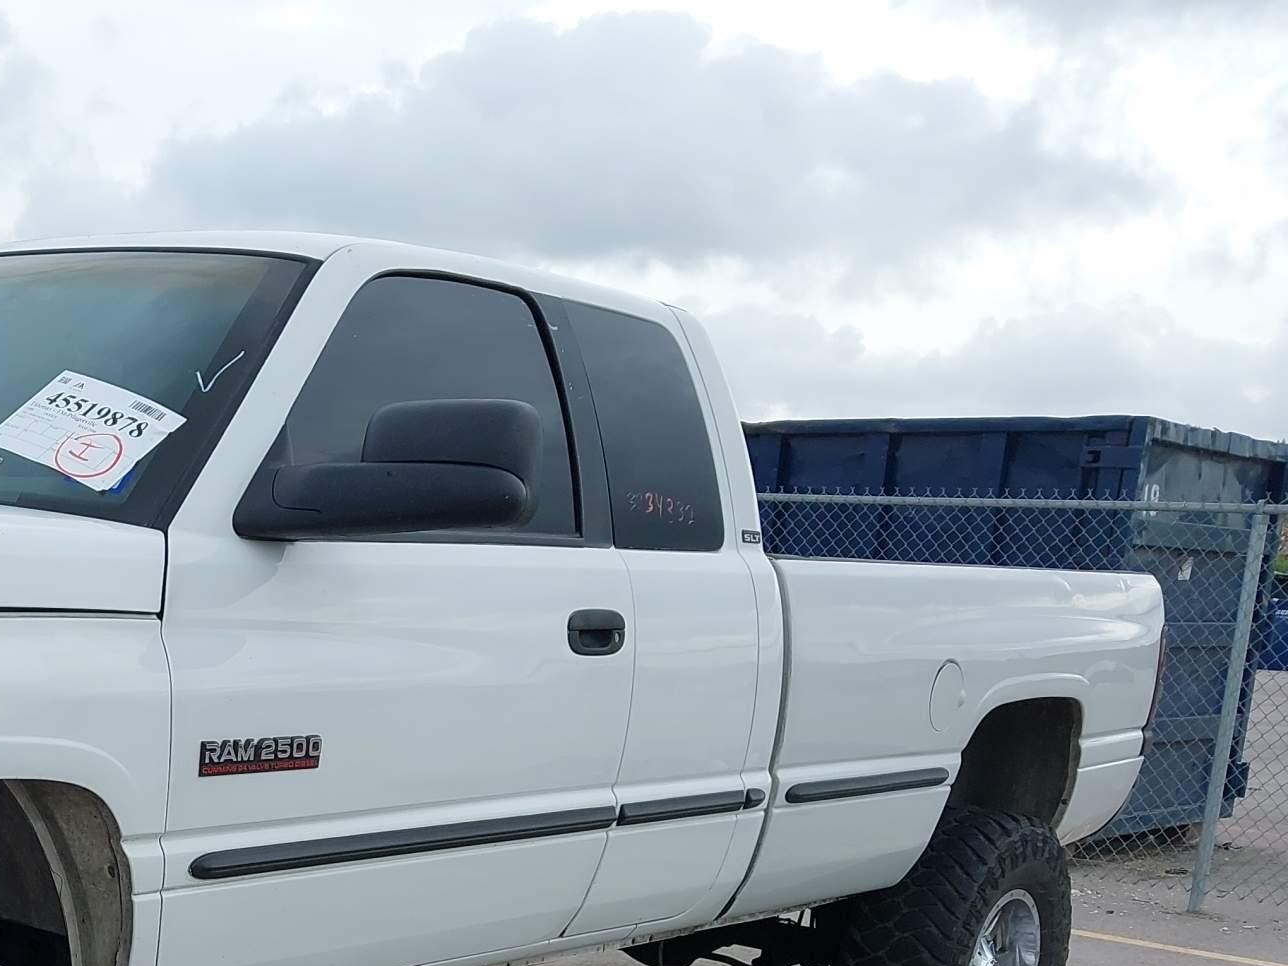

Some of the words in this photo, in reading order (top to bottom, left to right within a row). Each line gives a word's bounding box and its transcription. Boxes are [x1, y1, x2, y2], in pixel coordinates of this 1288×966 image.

[46, 392, 149, 438] 45519878
[743, 533, 761, 542] SLT
[203, 740, 256, 764] RAM
[259, 735, 323, 761] 2500
